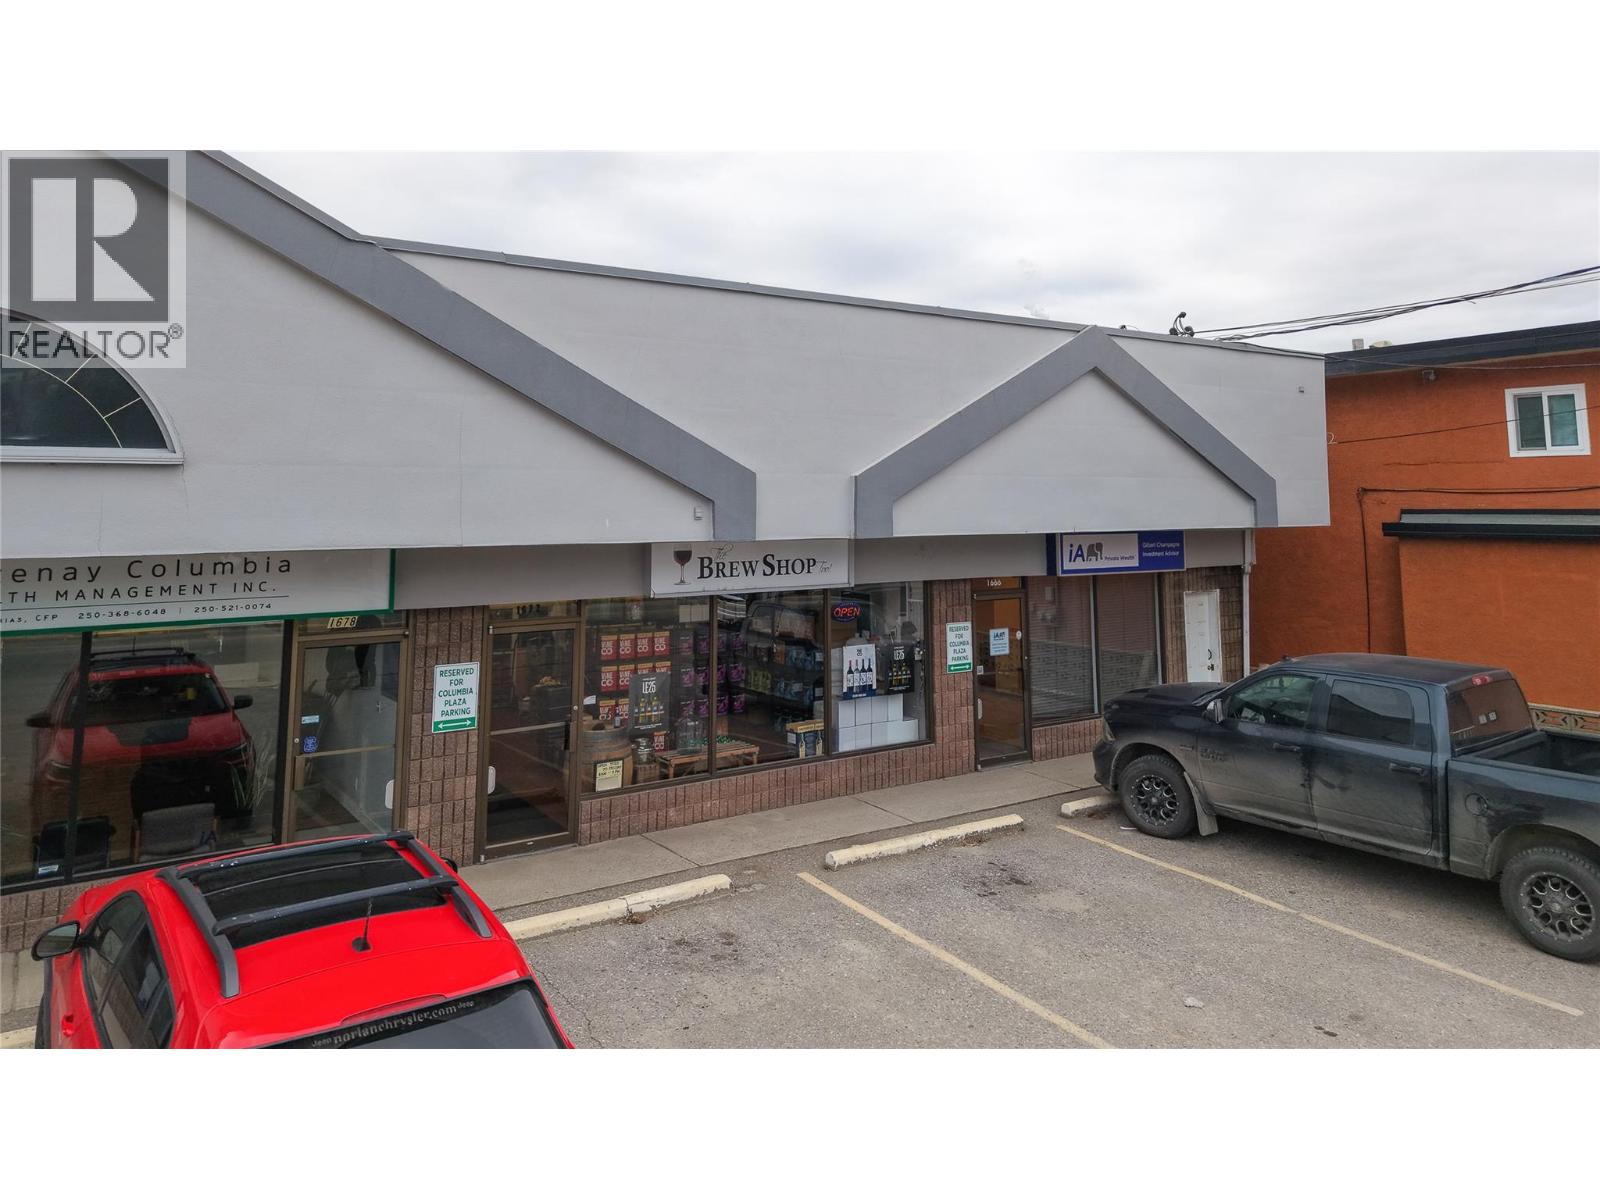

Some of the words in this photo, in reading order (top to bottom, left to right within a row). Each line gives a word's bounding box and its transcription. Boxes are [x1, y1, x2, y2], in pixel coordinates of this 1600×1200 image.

[0, 565, 101, 583] enay
[127, 556, 291, 579] Columbia
[0, 590, 37, 604] TH
[55, 583, 218, 601] MANAGEMENT
[233, 581, 276, 593] INC.
[0, 616, 28, 624] IAS,
[35, 614, 58, 622] CFP
[78, 608, 166, 620] 250-368-6048
[194, 603, 272, 613] 250-521-0074
[833, 607, 861, 617] OPEN
[330, 616, 357, 628] 1678
[949, 625, 970, 633] RESERVED
[949, 640, 970, 648] COLUMBIA
[440, 667, 475, 678] RESERVED
[449, 679, 464, 687] FOR
[438, 687, 474, 698] COLUMBIA
[444, 698, 467, 707] PLAZA
[440, 707, 471, 717] PARKING
